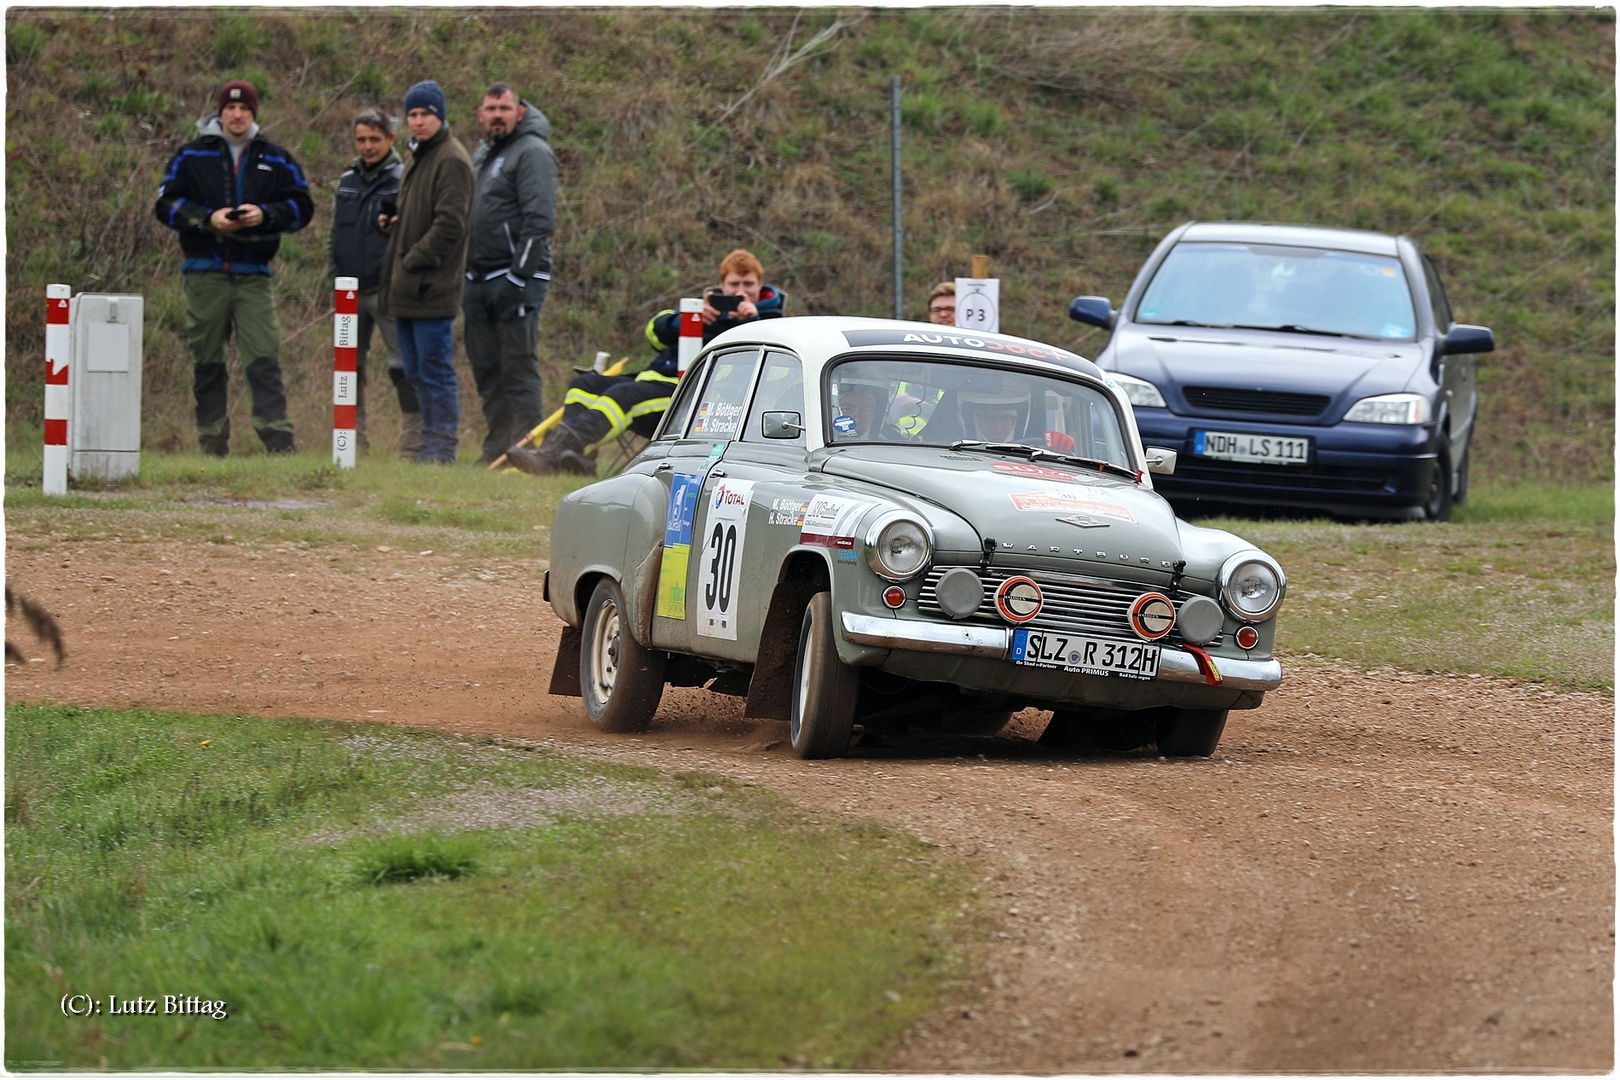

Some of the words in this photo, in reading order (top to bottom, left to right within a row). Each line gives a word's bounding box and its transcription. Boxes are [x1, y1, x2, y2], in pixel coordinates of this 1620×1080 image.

[966, 309, 974, 321] P
[977, 309, 985, 321] 3
[715, 402, 743, 420] Böttger
[701, 418, 709, 433] H.
[710, 418, 738, 433] Stracke
[1206, 435, 1237, 454] NDH
[1250, 438, 1271, 457] LS
[1275, 440, 1305, 459] 111
[724, 490, 745, 506] TOTAL
[780, 499, 803, 514] Böttger
[768, 512, 775, 525] H.
[775, 512, 798, 526] Stracke
[1002, 542, 1171, 568] WARTBURG
[705, 522, 737, 613] 30
[1015, 647, 1022, 655] D
[1027, 634, 1069, 662] SLZ
[1083, 641, 1098, 665] R
[1102, 643, 1158, 673] 312H
[1064, 665, 1081, 674] Auto
[1081, 668, 1109, 677] PRIMUS
